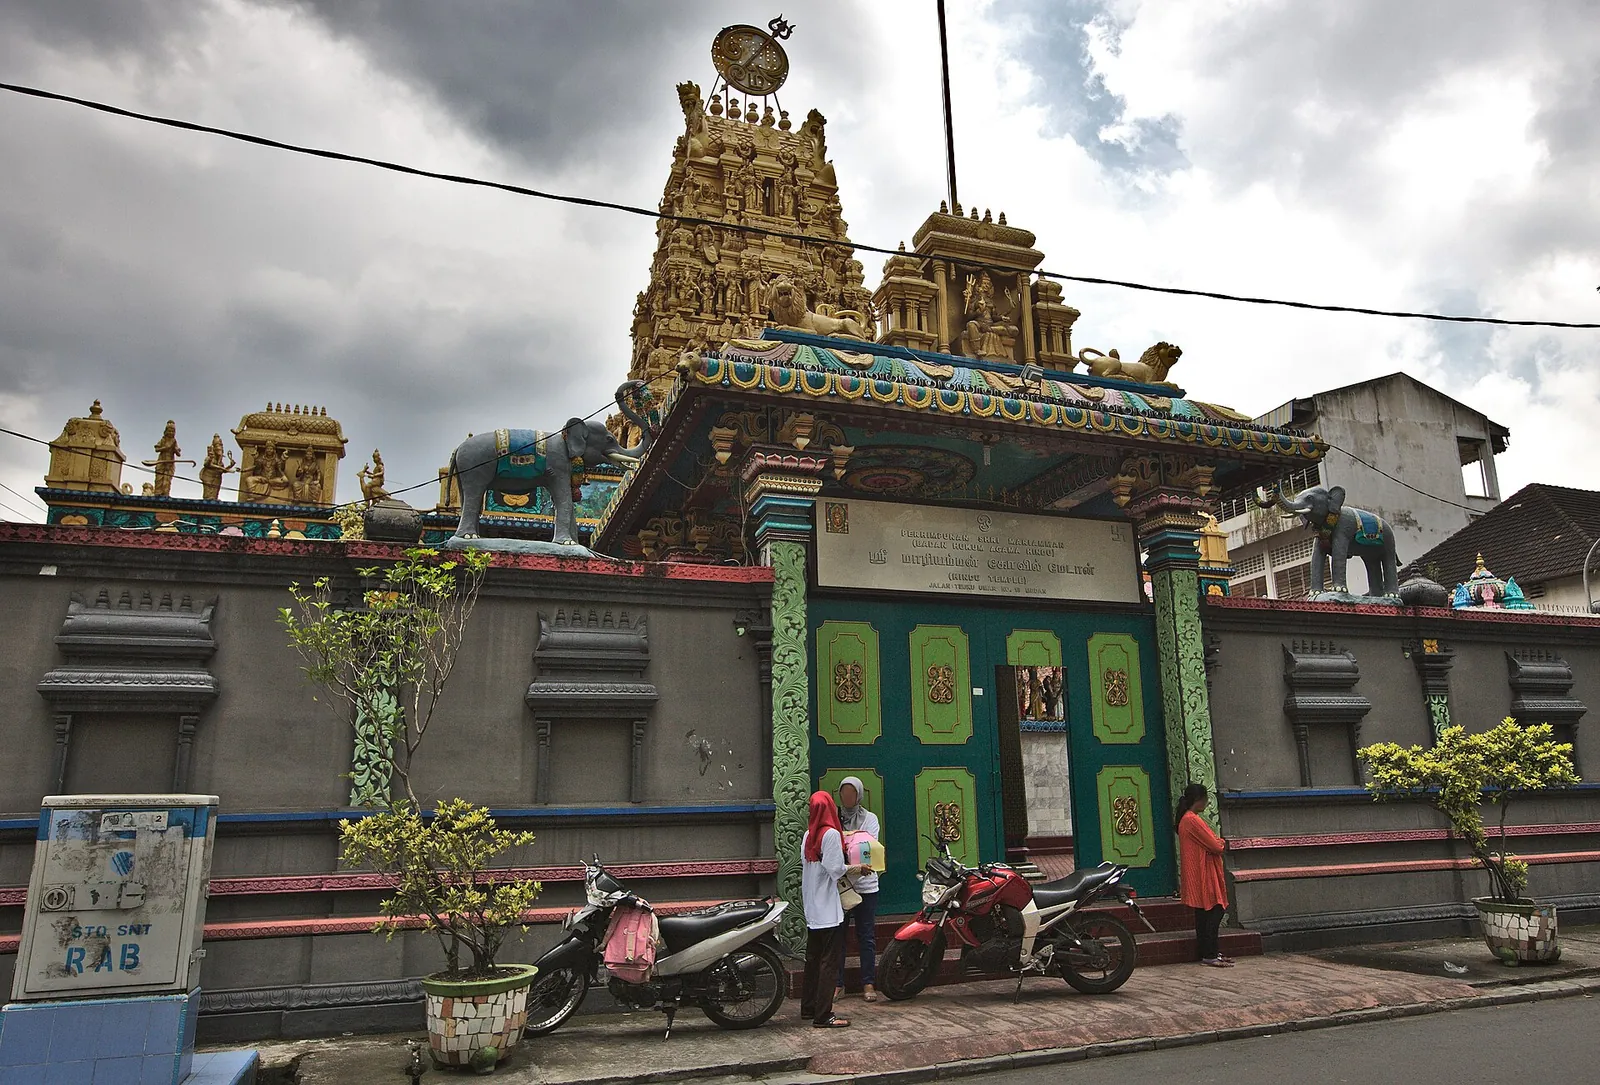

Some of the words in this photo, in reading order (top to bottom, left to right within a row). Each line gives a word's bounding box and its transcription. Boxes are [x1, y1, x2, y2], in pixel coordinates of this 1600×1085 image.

[978, 536, 1000, 545] SHRI
[952, 542, 984, 552] HUKUM
[989, 545, 1020, 555] AGAMA
[117, 923, 152, 937] SNT
[65, 943, 140, 974] RAB
